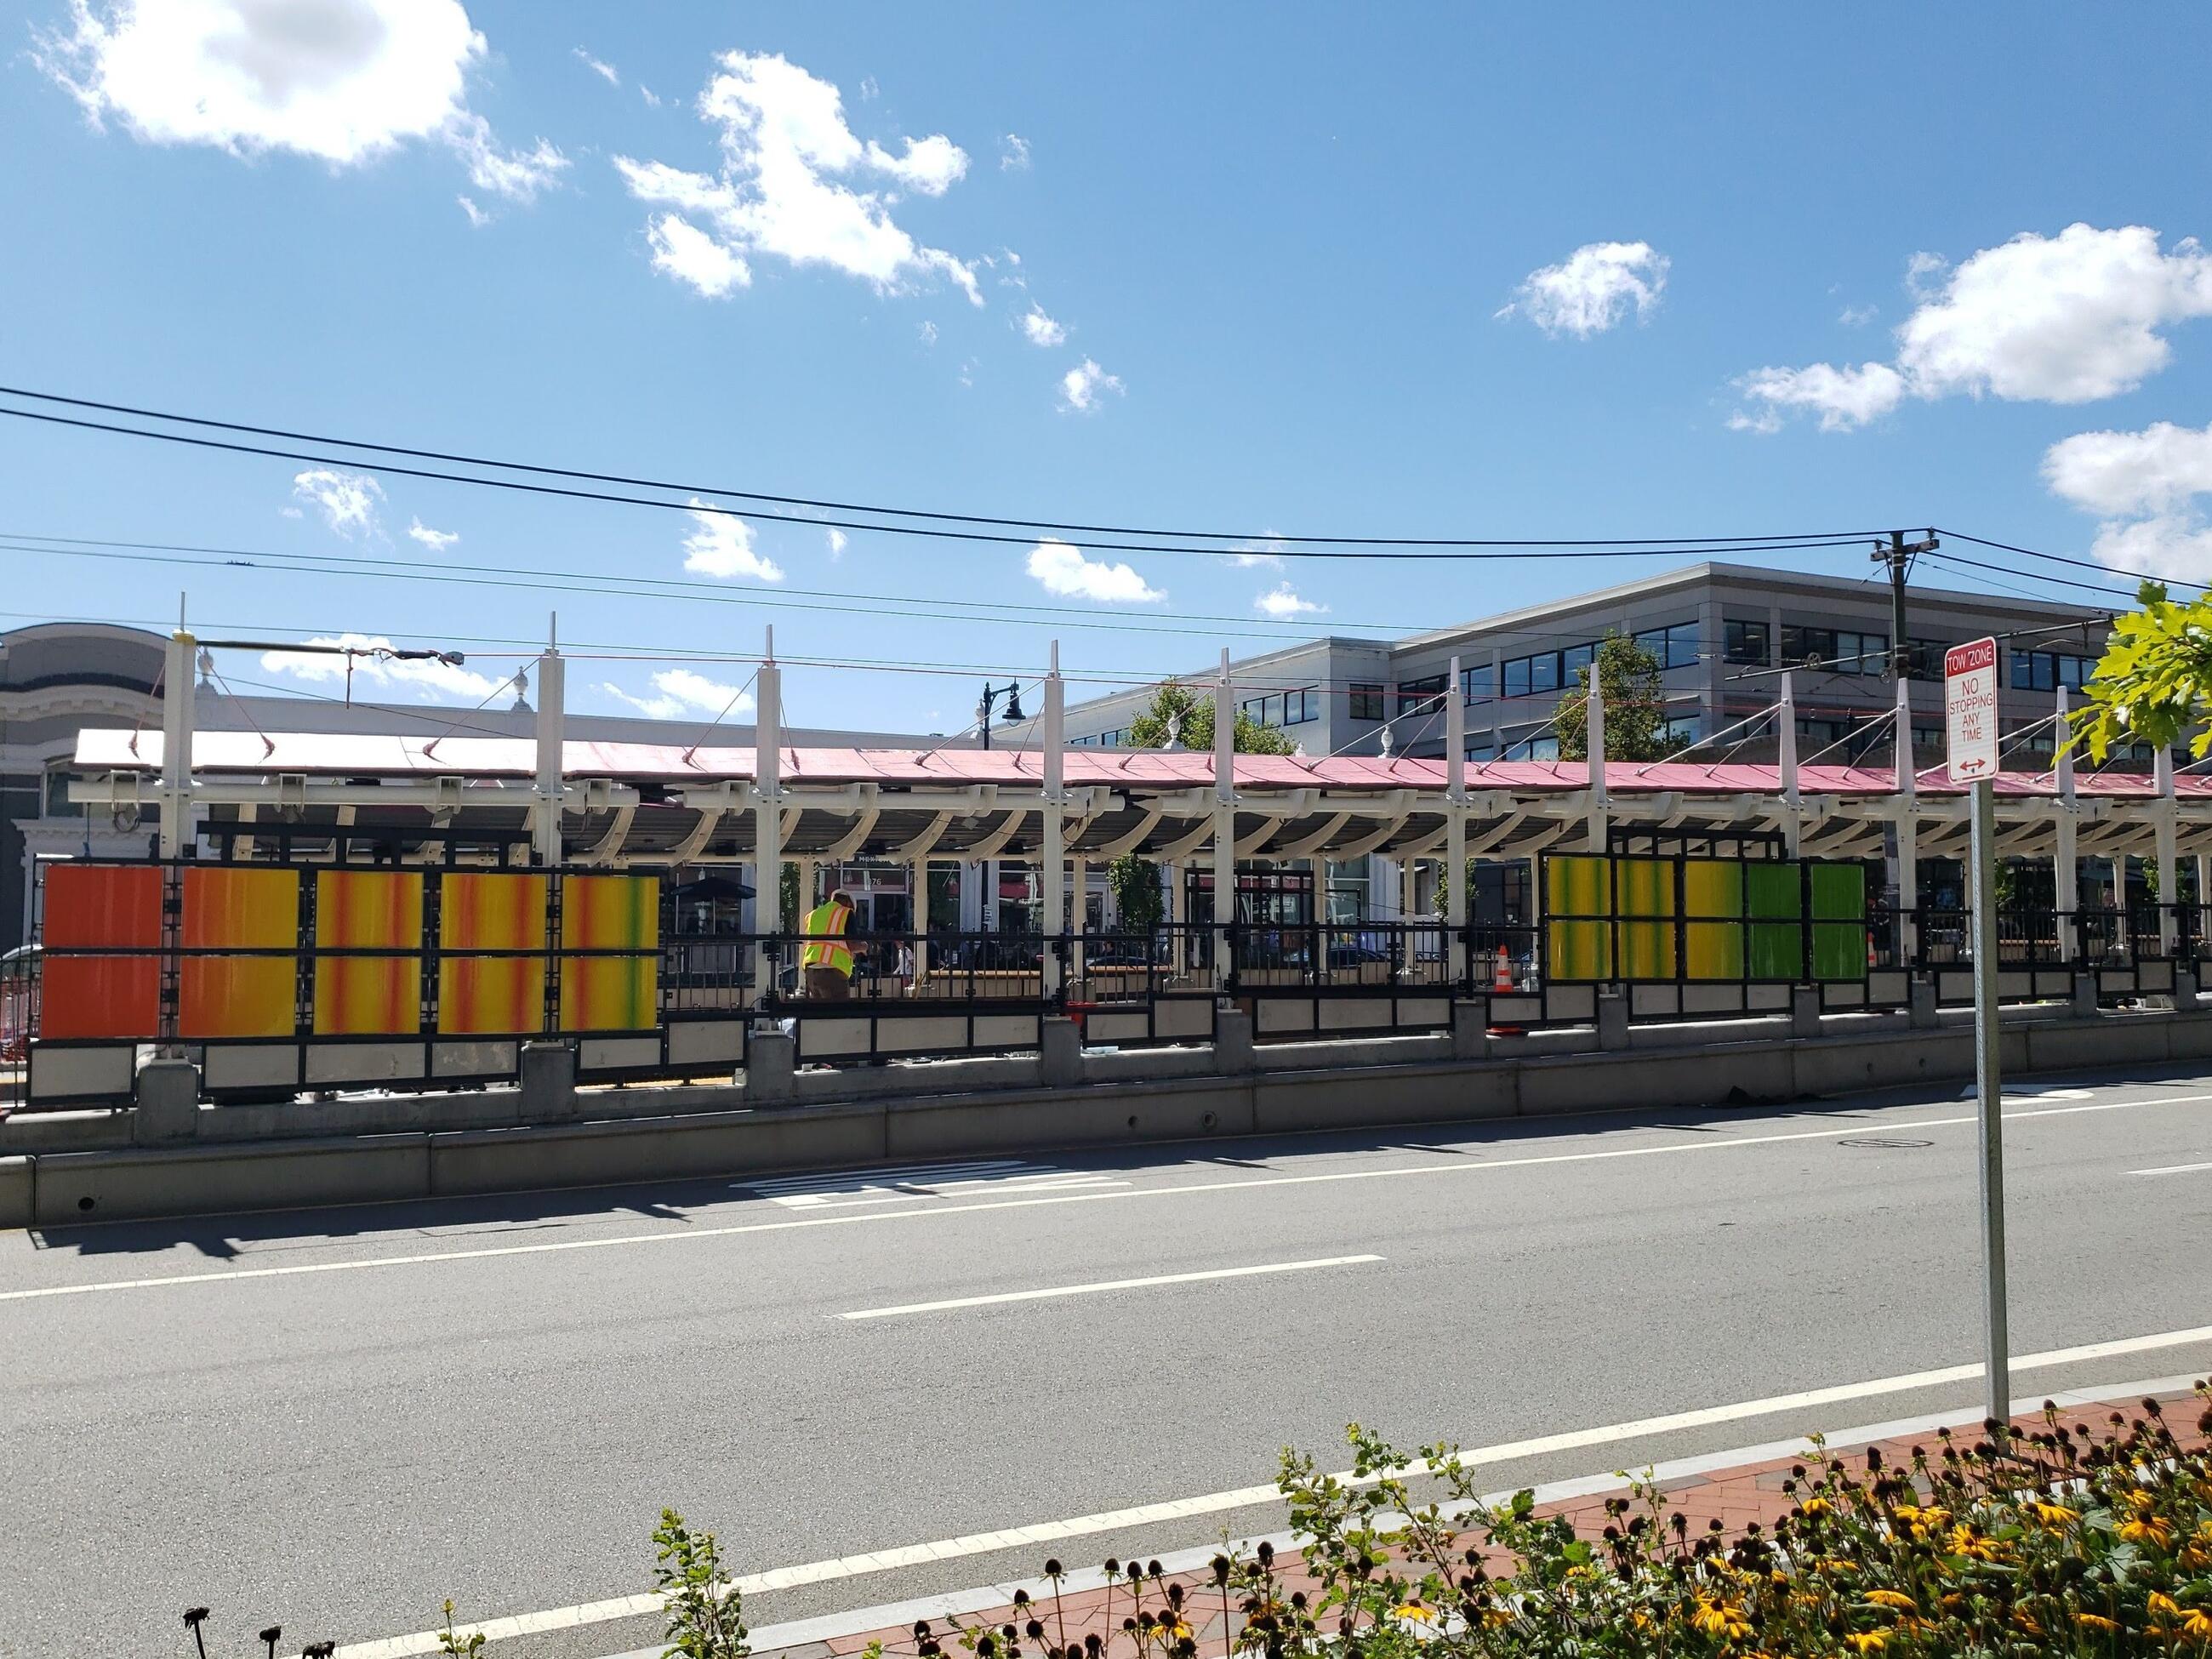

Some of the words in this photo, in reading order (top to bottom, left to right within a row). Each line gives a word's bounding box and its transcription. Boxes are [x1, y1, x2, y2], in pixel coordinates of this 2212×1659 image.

[1947, 654, 1966, 672] TOW
[1969, 646, 1993, 666] ZONE
[1962, 677, 1979, 697] NO
[1949, 693, 1993, 715] STOPPING
[1962, 712, 1981, 727] ANY
[1962, 727, 1982, 743] TIME
